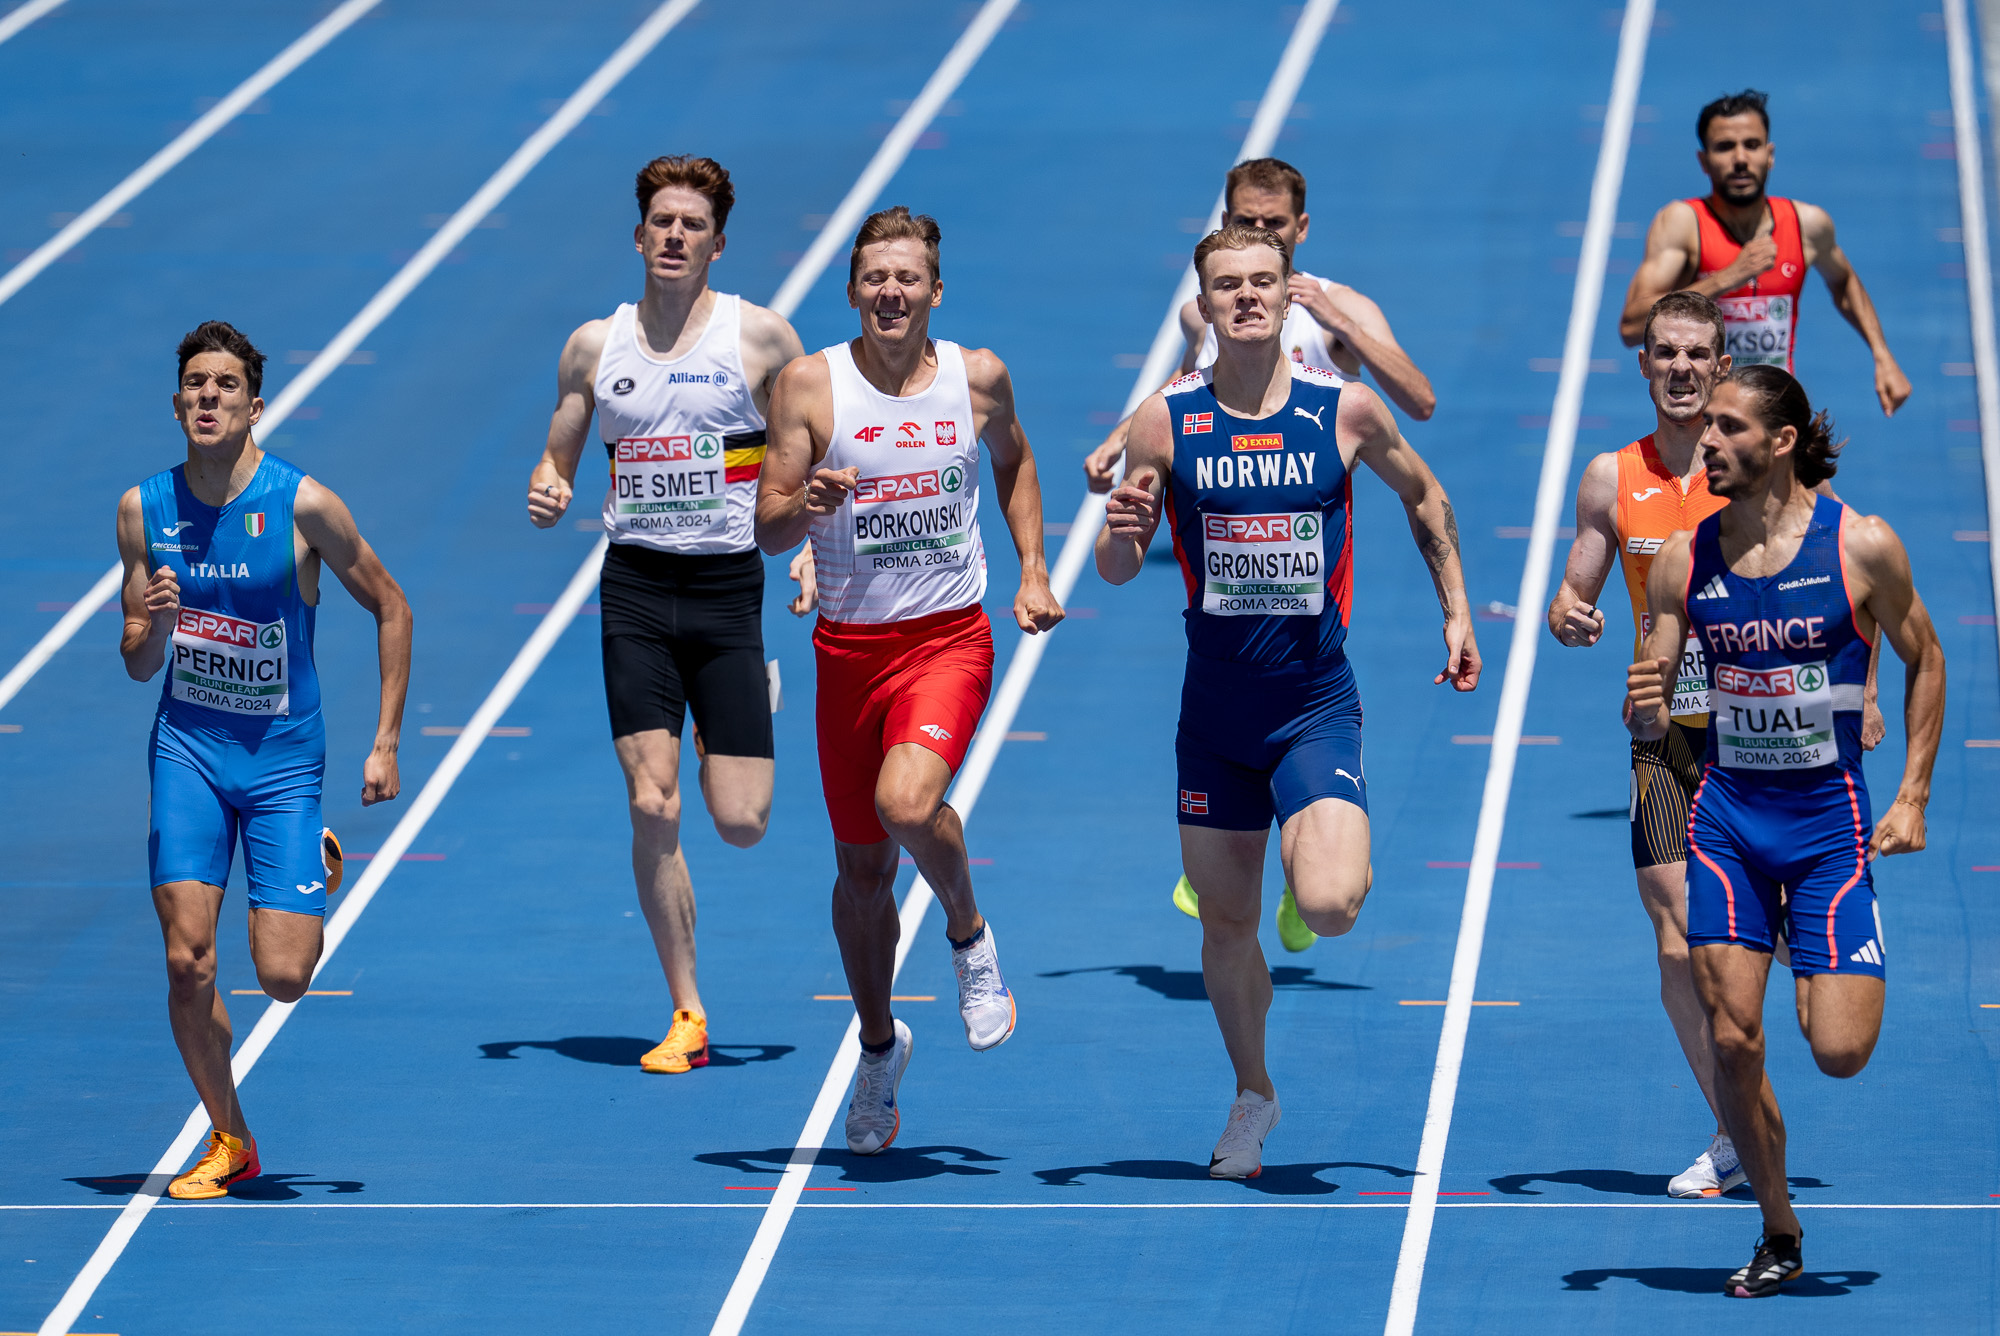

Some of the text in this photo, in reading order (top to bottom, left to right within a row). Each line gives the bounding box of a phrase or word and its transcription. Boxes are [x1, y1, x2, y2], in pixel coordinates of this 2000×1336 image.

[1726, 326, 1786, 352] KSÖZ
[668, 373, 710, 385] Allianz
[854, 427, 885, 443] 4F
[1250, 438, 1280, 446] EXTRA
[618, 439, 690, 461] SPAR
[1196, 452, 1316, 490] NORWAY
[618, 470, 718, 499] DE SMET
[856, 474, 938, 500] SPAR
[640, 503, 662, 513] RUN
[630, 514, 712, 529] ROMA 2024
[855, 501, 962, 540] BORKOWSKI
[1208, 518, 1289, 539] SPAR
[152, 542, 199, 551] FRECCIAROSSA
[886, 543, 910, 552] RUN
[1626, 536, 1666, 555] ES
[873, 549, 960, 569] ROMA 2024
[1208, 551, 1319, 580] GRØNSTAD
[190, 562, 250, 578] ITALIA
[1806, 575, 1831, 585] Mutuel
[1232, 585, 1257, 594] RUN
[1219, 598, 1309, 611] ROMA 2024
[180, 613, 255, 645] SPAR
[1705, 616, 1827, 653] FRANCE
[176, 645, 282, 682] PERNICI
[200, 677, 222, 692] RUN
[1674, 683, 1689, 692] UN
[1717, 670, 1793, 694] SPAR
[187, 687, 272, 711] ROMA 2024
[1729, 705, 1815, 733] TUAL
[920, 724, 952, 740] 4F
[1744, 738, 1769, 748] RUN
[1735, 748, 1821, 765] ROMA 2024
